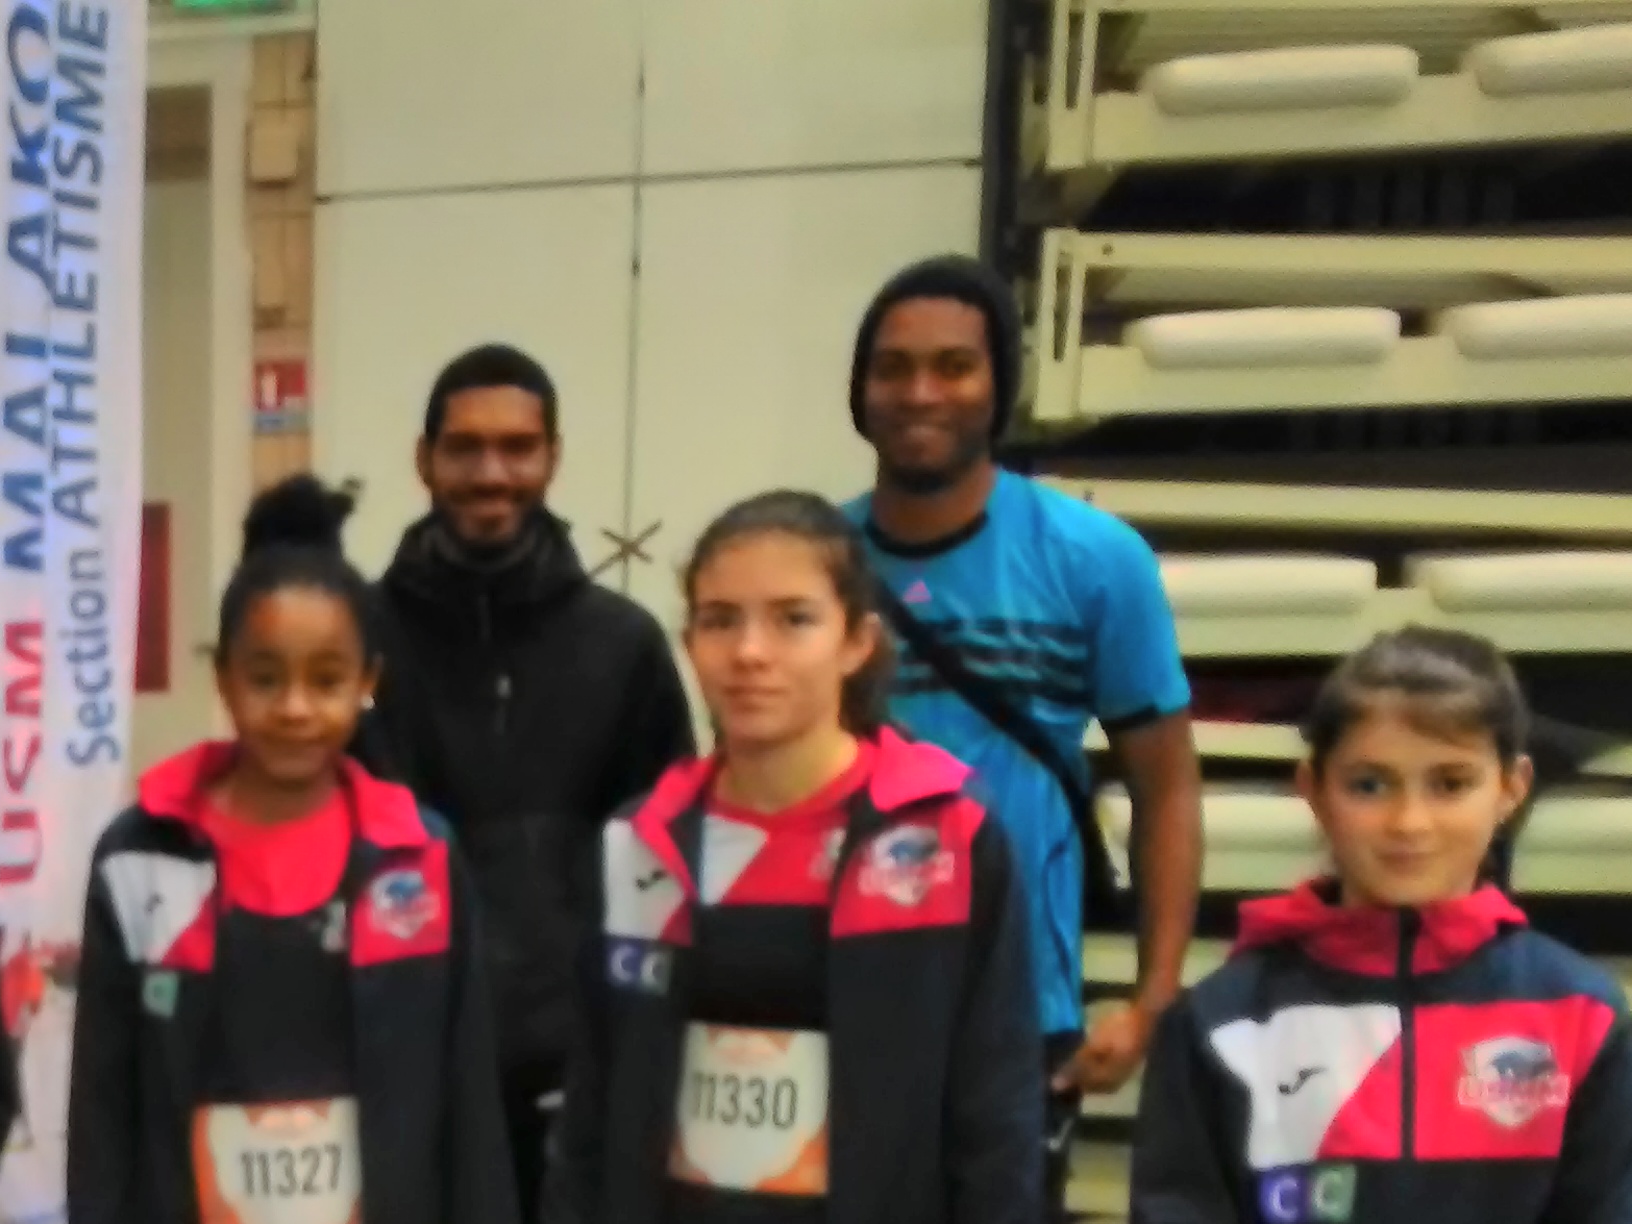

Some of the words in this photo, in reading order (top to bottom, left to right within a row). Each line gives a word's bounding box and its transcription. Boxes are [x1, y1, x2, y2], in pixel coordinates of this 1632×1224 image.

[51, 0, 109, 528] ATHLETISME
[57, 549, 120, 767] Section
[240, 1143, 343, 1197] 11327
[693, 1071, 799, 1131] 11330
